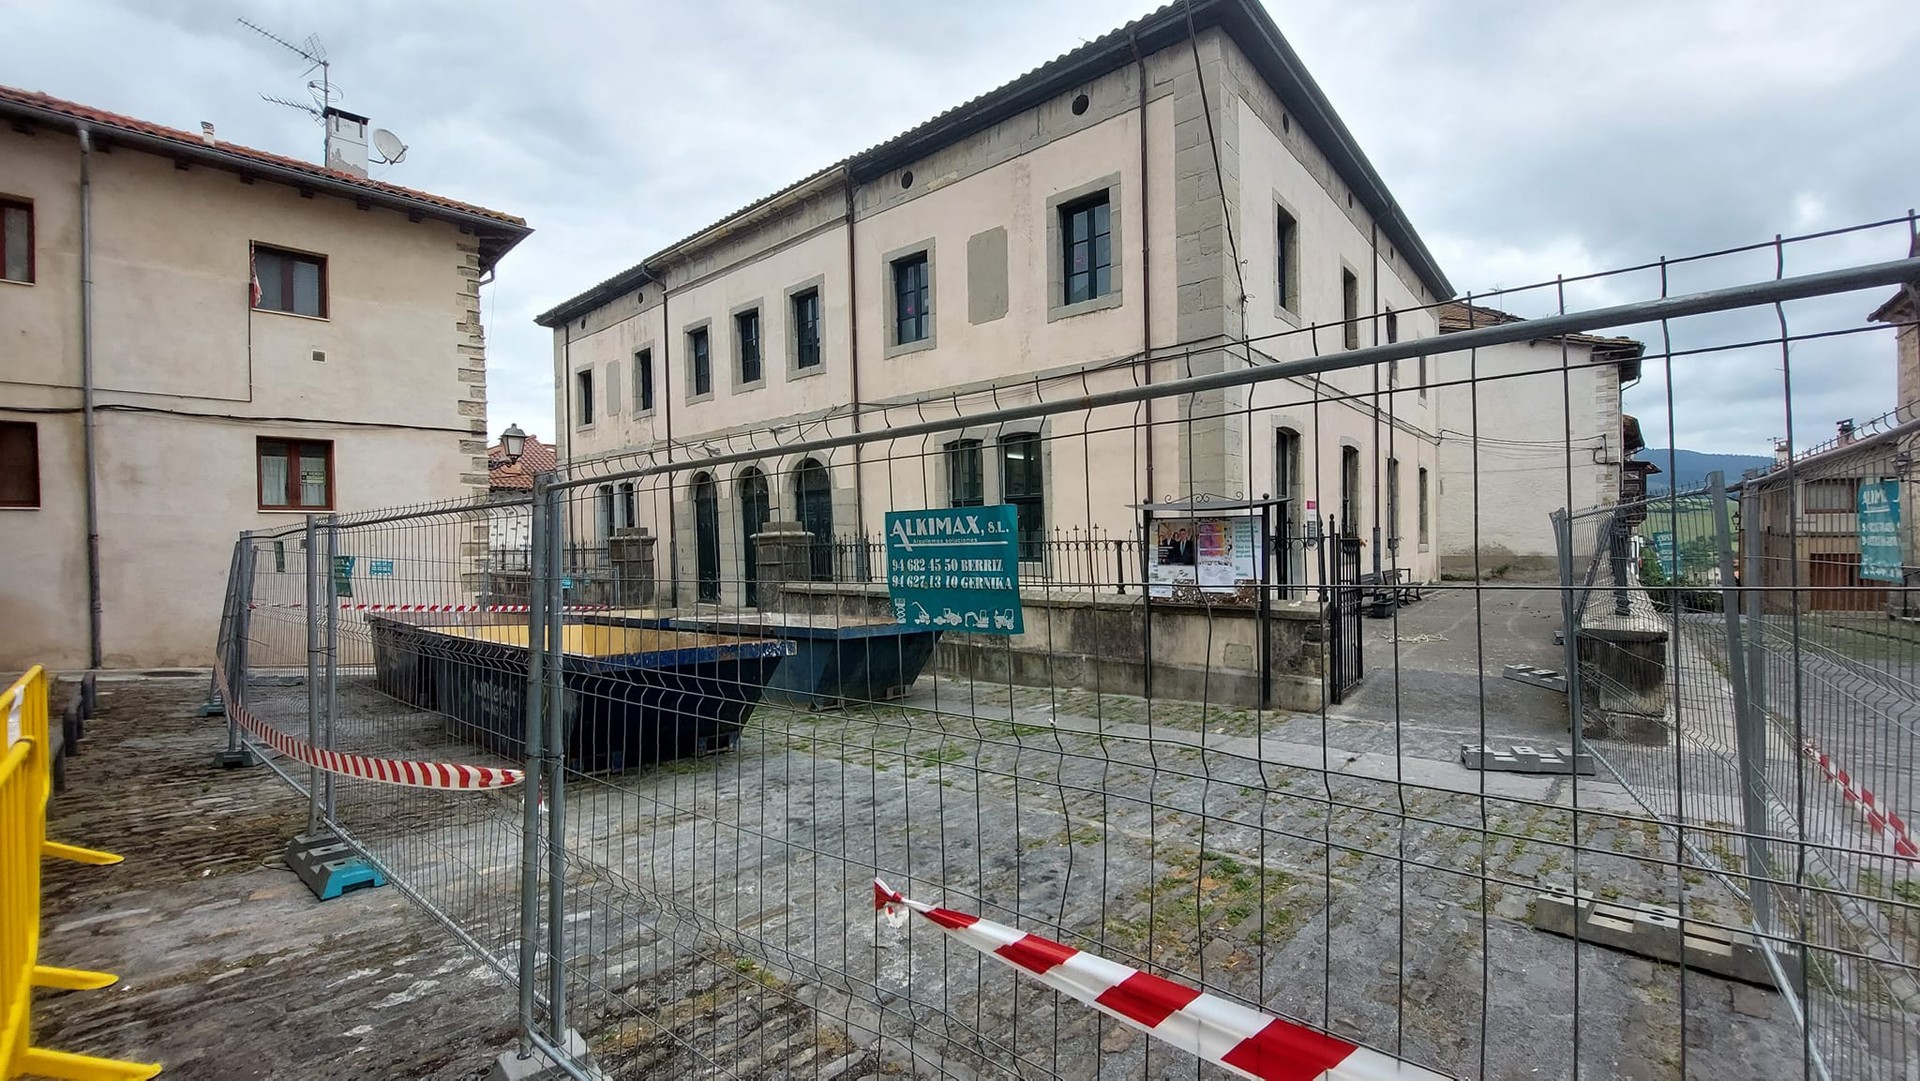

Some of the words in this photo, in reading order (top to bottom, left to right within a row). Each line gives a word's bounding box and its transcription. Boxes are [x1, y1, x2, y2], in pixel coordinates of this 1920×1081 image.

[889, 516, 984, 552] ALKIMAX,
[988, 521, 1009, 533] S.L.
[892, 559, 904, 572] 94
[907, 558, 926, 572] 682
[928, 559, 941, 572] 45
[944, 558, 958, 572] 50
[961, 559, 1003, 572] BERRIZ
[892, 575, 905, 588] 94
[907, 575, 926, 588] 627
[929, 575, 941, 588] 13
[945, 576, 958, 588] 10
[961, 577, 1013, 590] GERNIKA
